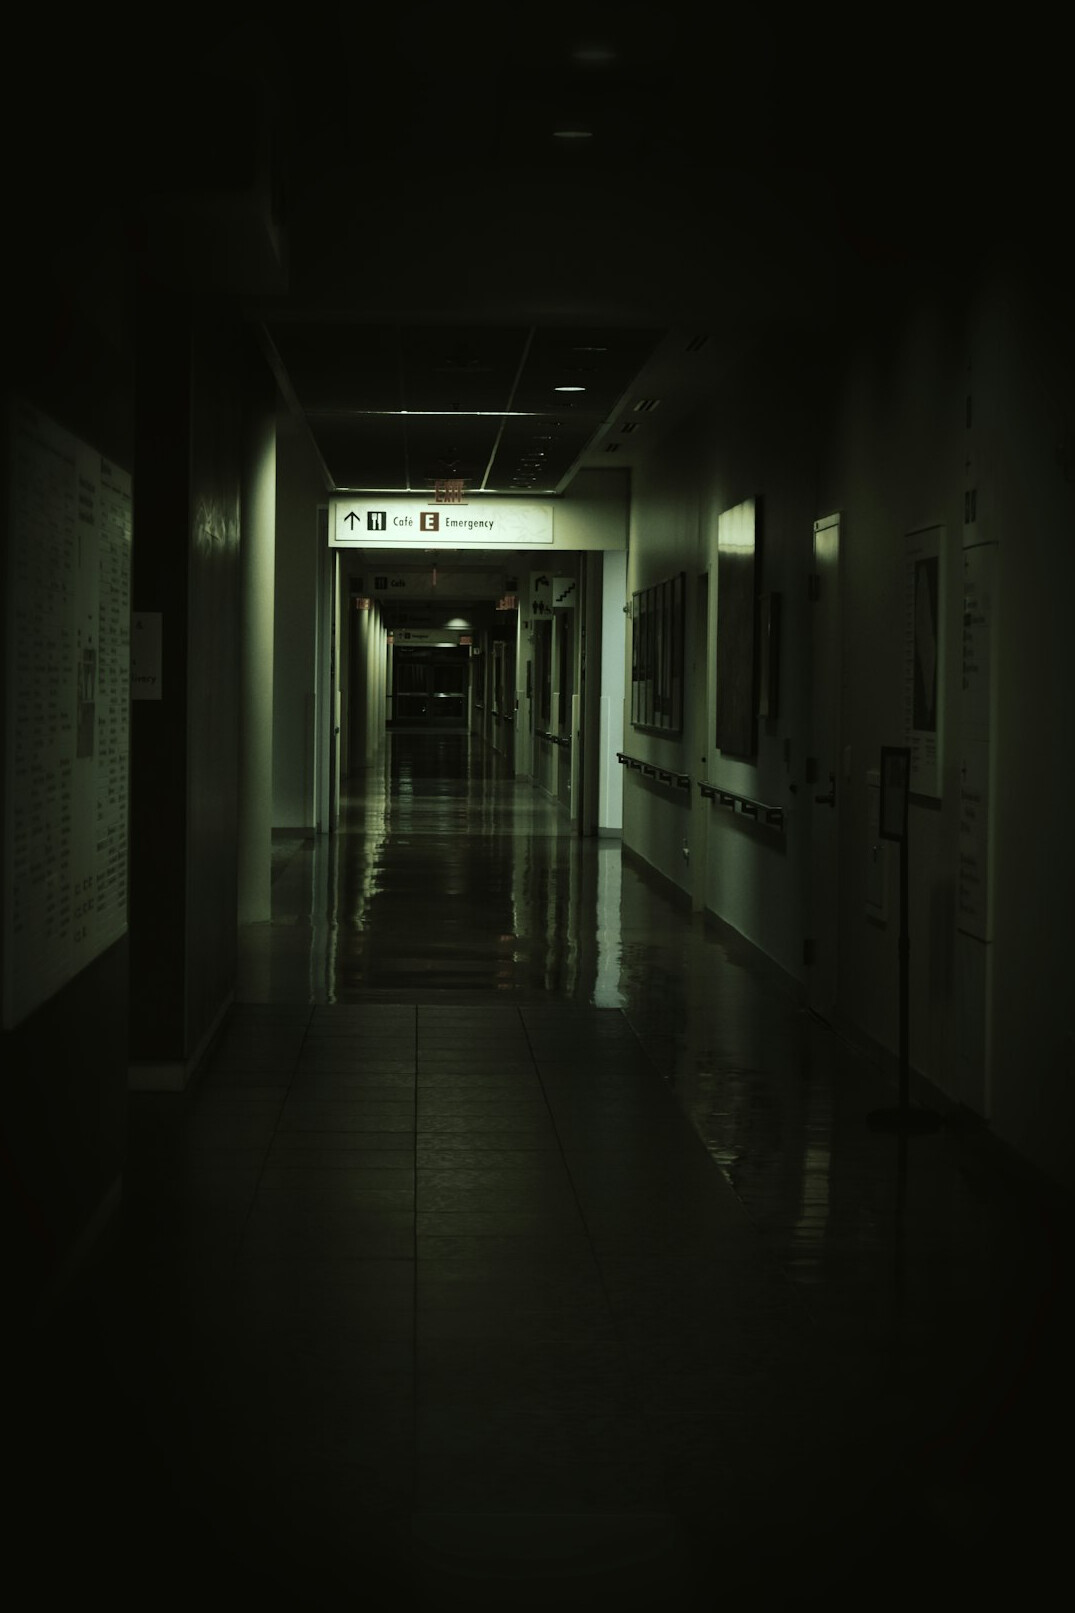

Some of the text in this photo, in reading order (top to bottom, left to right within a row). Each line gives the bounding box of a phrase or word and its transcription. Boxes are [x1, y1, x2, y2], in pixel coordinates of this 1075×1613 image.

[435, 480, 464, 503] EXIT
[393, 514, 494, 530] Café E Emergency
